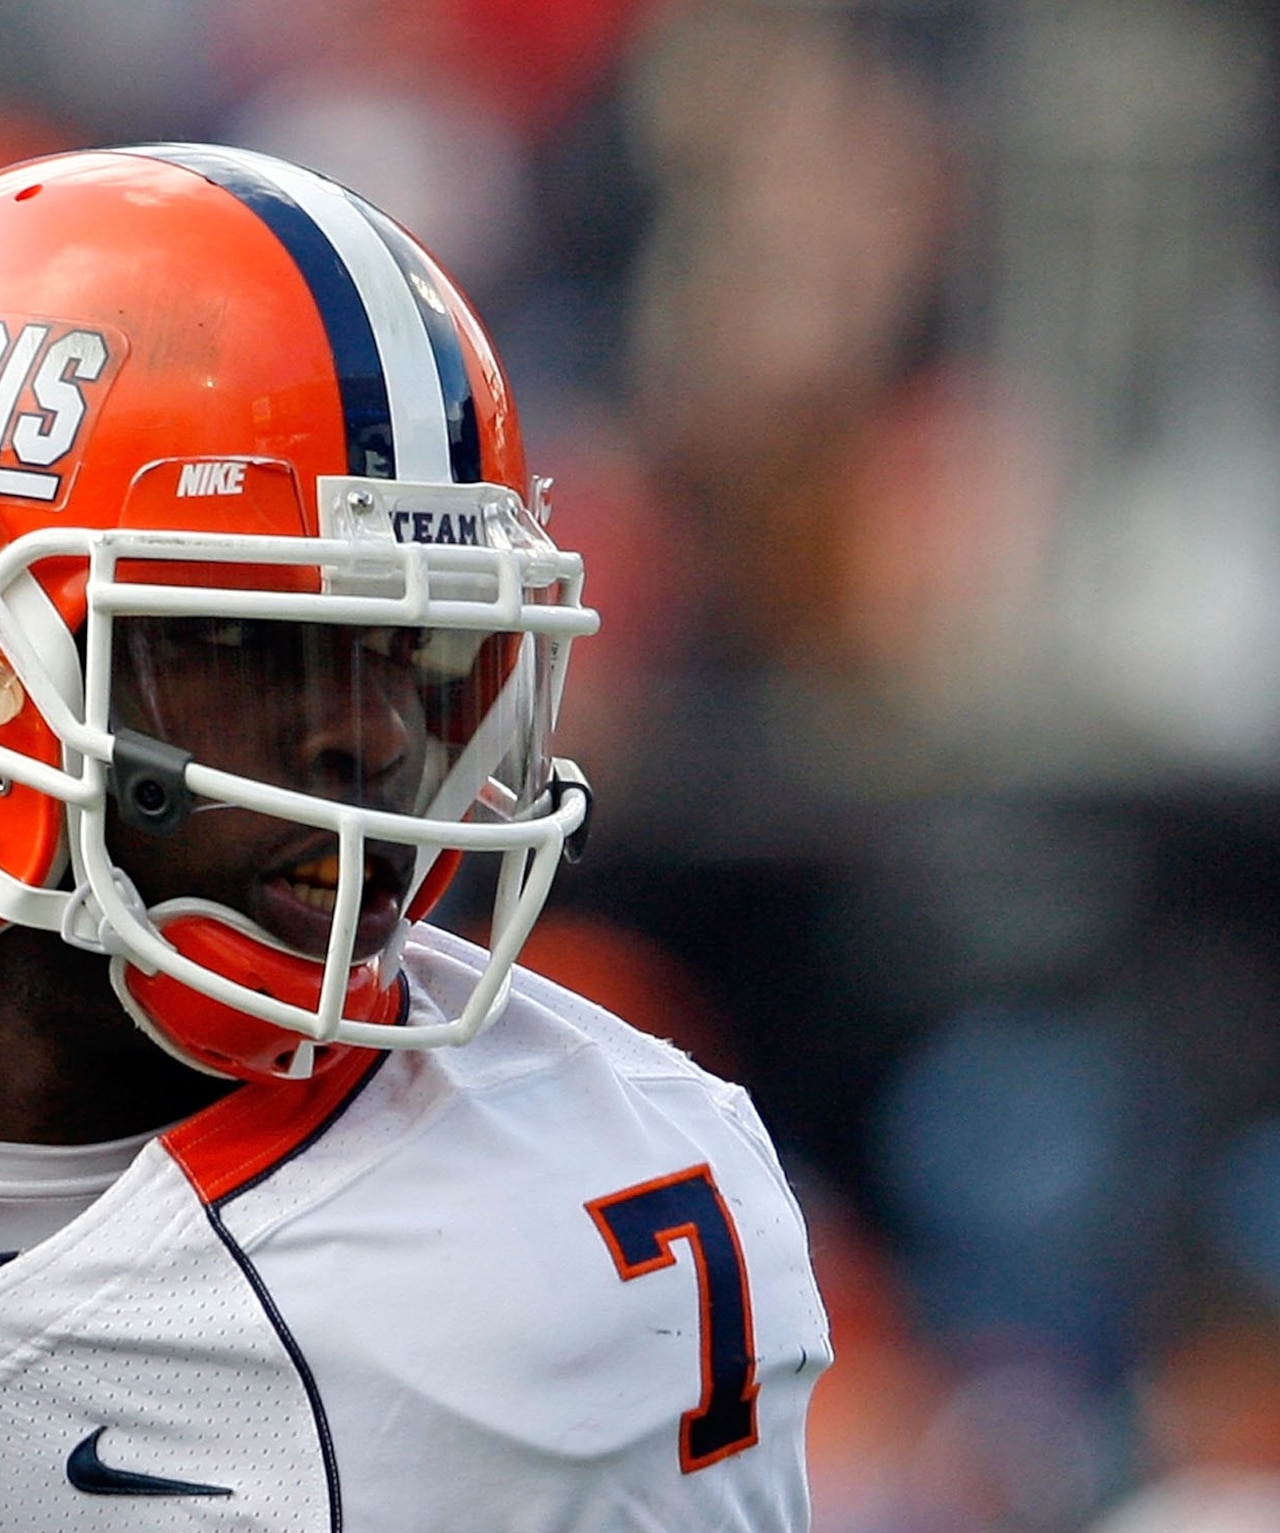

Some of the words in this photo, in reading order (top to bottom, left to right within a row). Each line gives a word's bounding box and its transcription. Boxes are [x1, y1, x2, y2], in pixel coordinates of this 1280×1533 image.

[176, 462, 246, 498] NIKE
[389, 511, 479, 544] TEAM
[583, 1162, 762, 1475] 7
